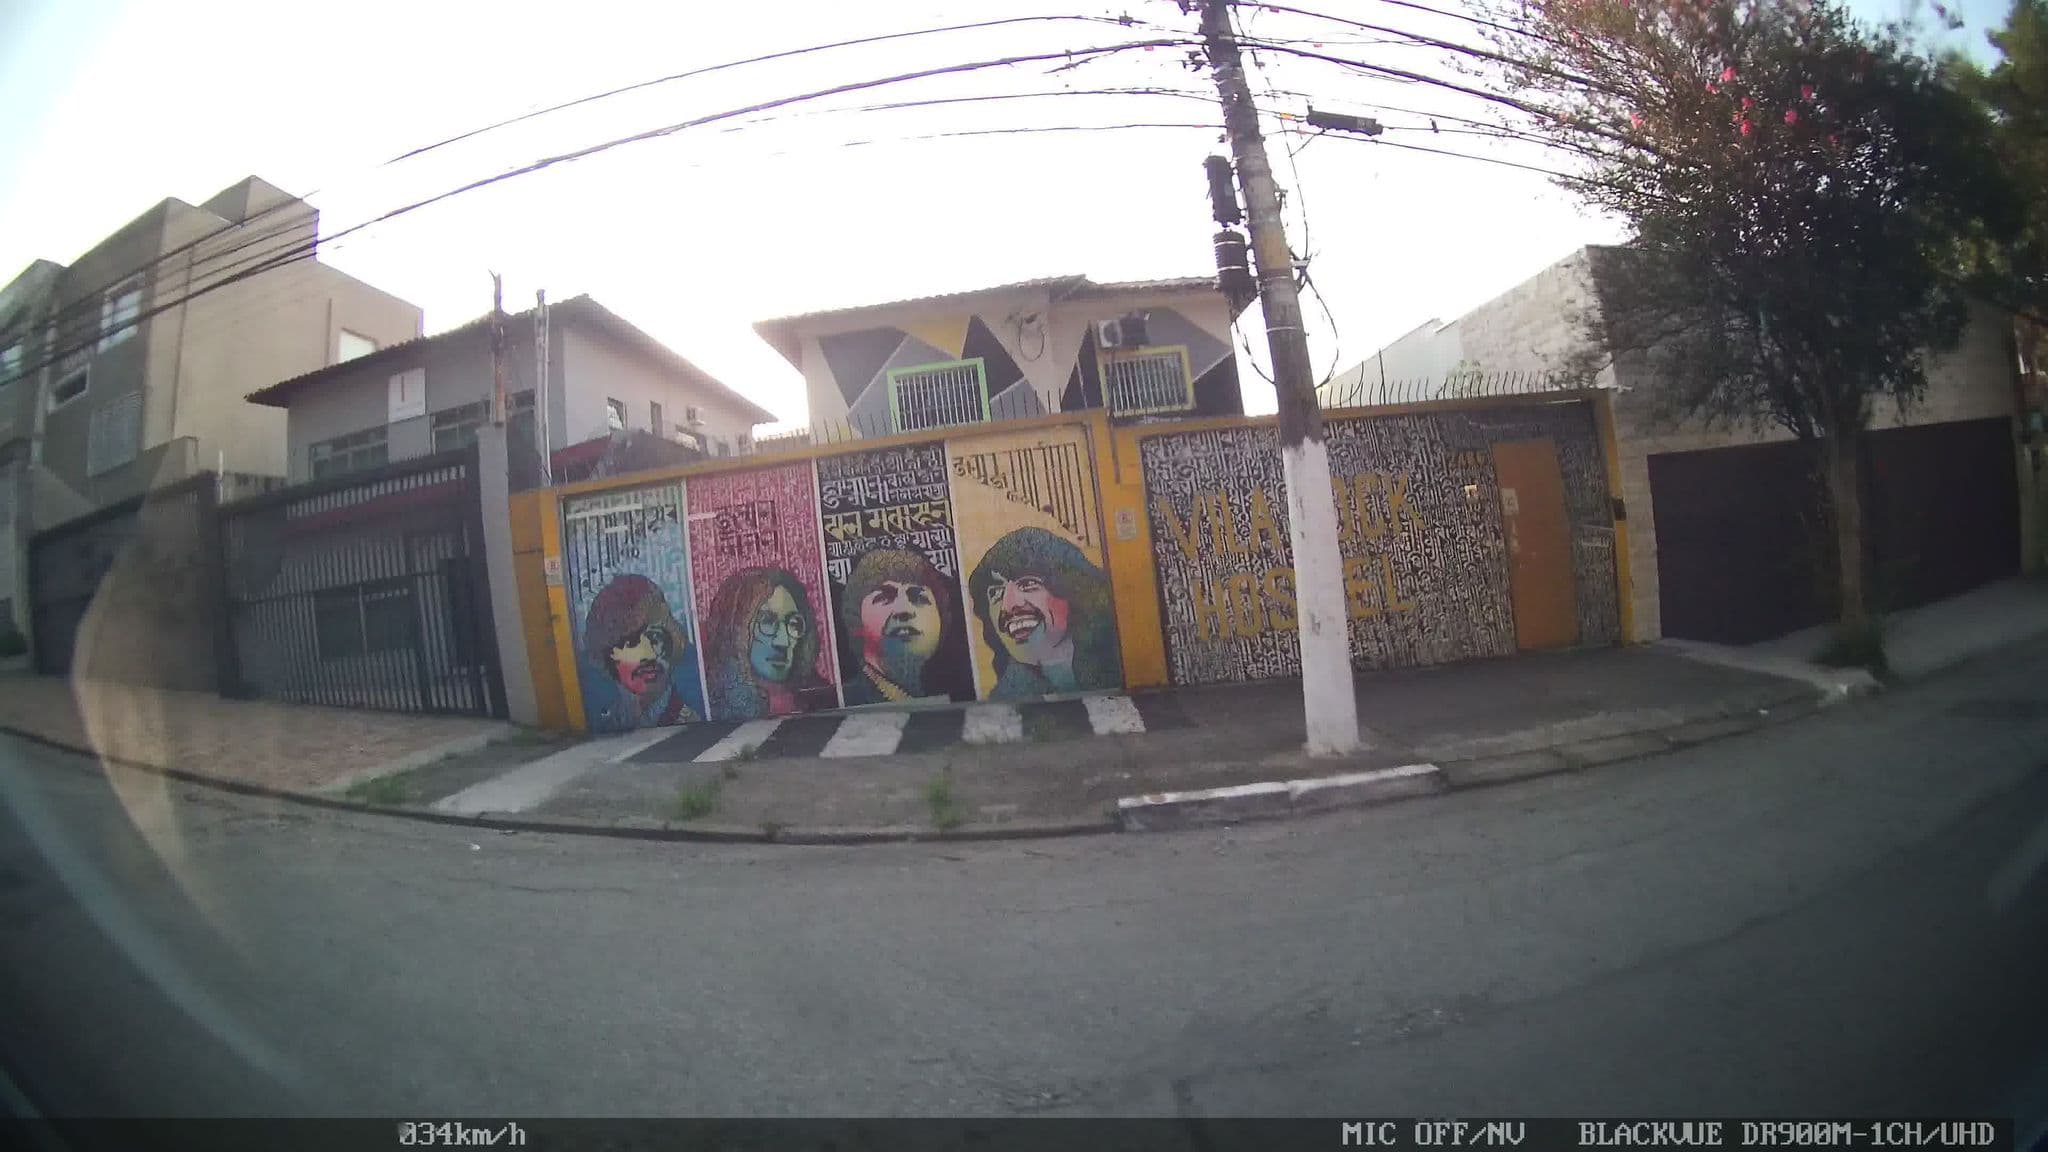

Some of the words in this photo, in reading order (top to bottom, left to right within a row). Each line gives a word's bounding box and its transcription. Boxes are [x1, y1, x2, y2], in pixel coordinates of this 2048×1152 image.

[1158, 485, 1282, 559] VILA
[1331, 470, 1426, 541] OCK
[1193, 554, 1417, 640] HOSEL
